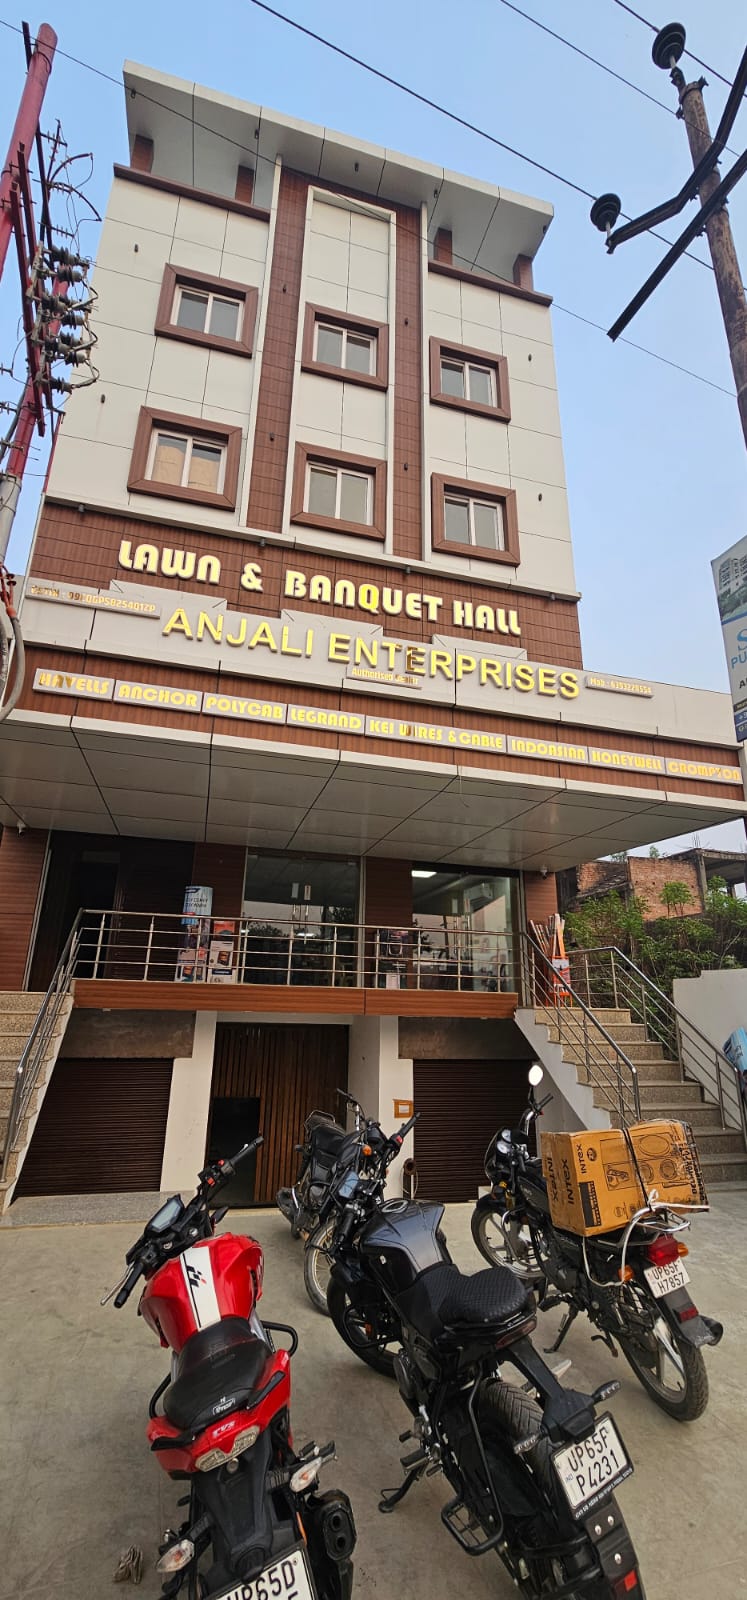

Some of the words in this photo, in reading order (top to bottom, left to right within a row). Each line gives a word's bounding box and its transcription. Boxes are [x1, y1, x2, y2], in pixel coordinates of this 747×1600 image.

[119, 540, 222, 585] LAWN
[240, 562, 265, 593] &
[284, 569, 442, 622] BANQUET
[453, 600, 522, 636] HALL
[162, 607, 315, 658] ANJALI
[328, 632, 580, 699] ENTERPRISES
[39, 672, 109, 695] HAVELLS
[118, 684, 197, 707] ANCHOR
[205, 697, 283, 719] POLYCAB
[290, 708, 362, 729] LEGRAND
[369, 720, 394, 734] KEI
[400, 723, 443, 740] WIRES
[448, 731, 457, 743] &
[460, 732, 503, 748] CABLE
[511, 739, 586, 760] INDOASIAN
[592, 750, 662, 770] HONEYWELL
[668, 761, 741, 781] CROMPTON
[657, 1272, 685, 1294] H7857
[568, 1427, 609, 1472] UP65F
[576, 1449, 619, 1496] P4231
[226, 1560, 296, 1600] P65D
